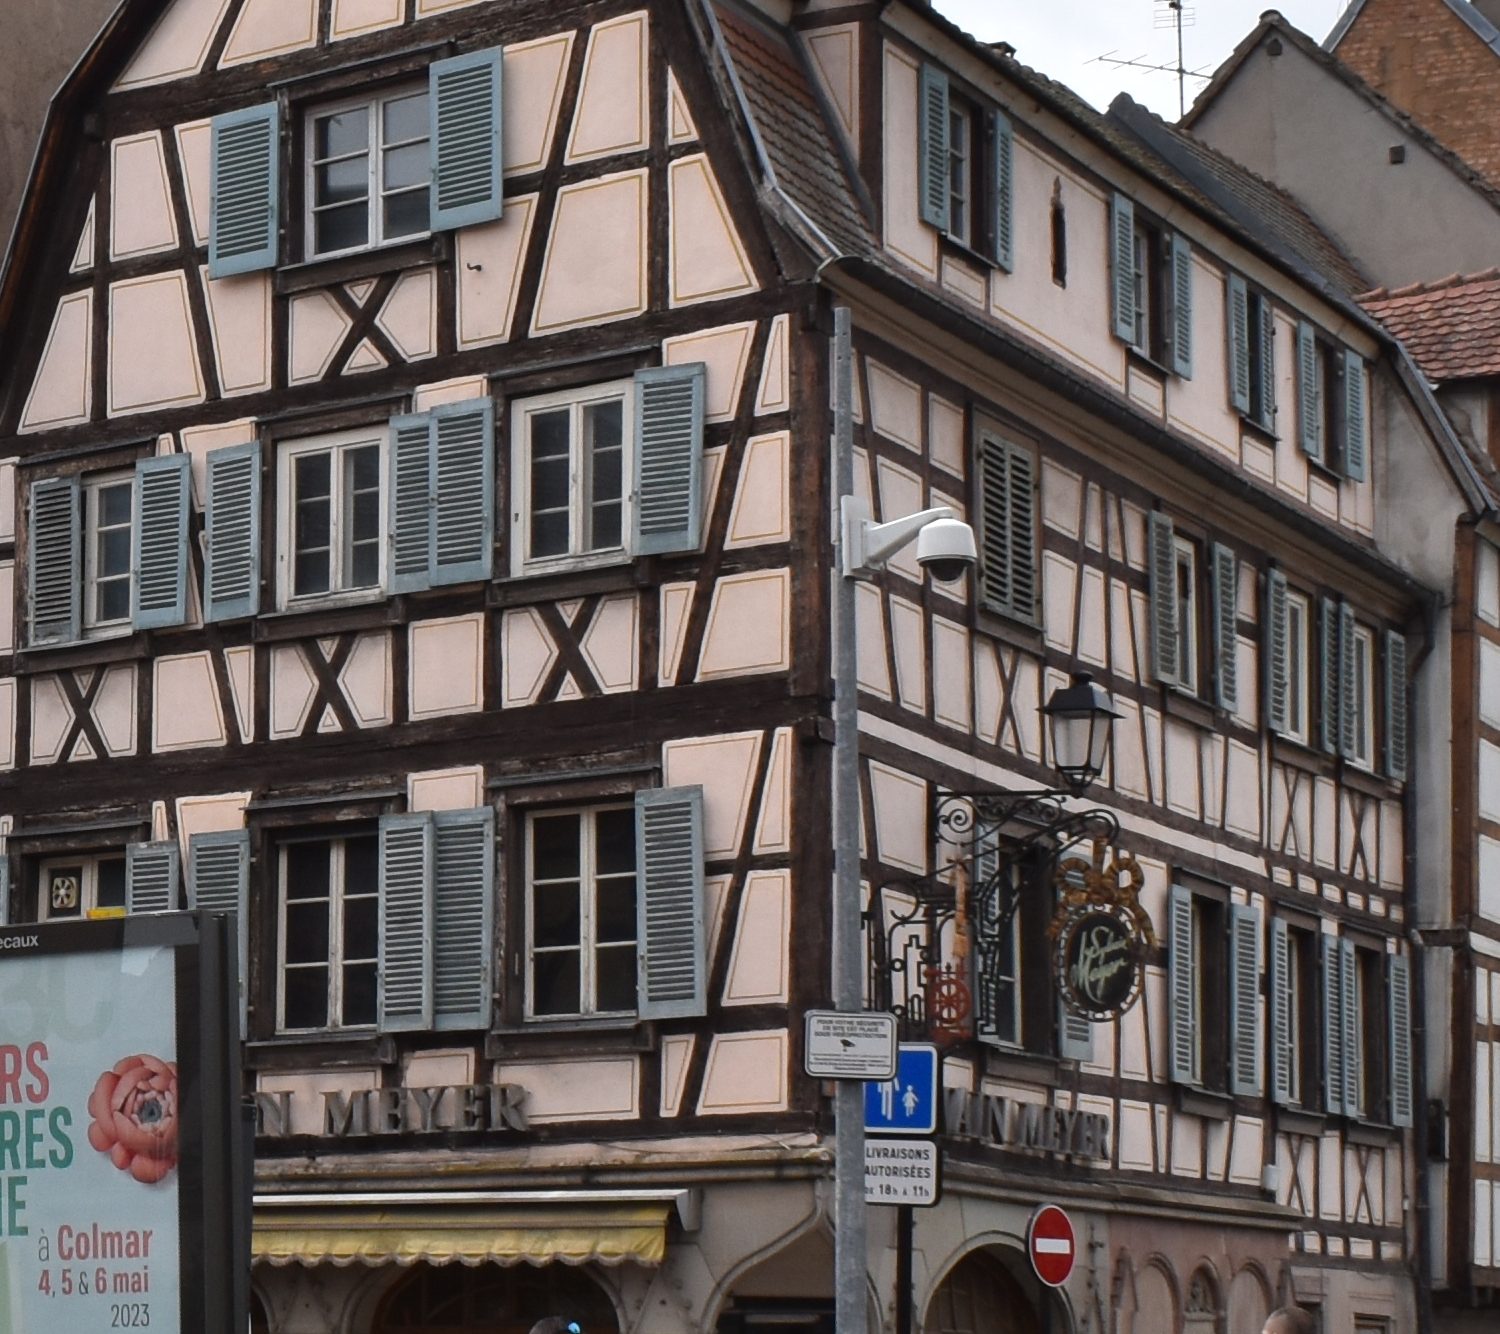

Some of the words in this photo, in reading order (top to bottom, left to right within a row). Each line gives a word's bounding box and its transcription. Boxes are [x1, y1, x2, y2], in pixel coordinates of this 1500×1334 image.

[320, 1083, 529, 1139] MEYER
[942, 1087, 1009, 1146] VAIN
[866, 1147, 930, 1161] LIVRAISONS
[865, 1163, 931, 1178] AUTORISÉES
[880, 1184, 898, 1196] 18h
[39, 1229, 50, 1262] à
[57, 1223, 153, 1260] Colmar
[38, 1269, 56, 1298] 4,
[62, 1269, 73, 1295] 5
[78, 1271, 89, 1295] &
[95, 1267, 107, 1294] 6
[113, 1266, 149, 1294] mai
[110, 1303, 150, 1327] 2023
